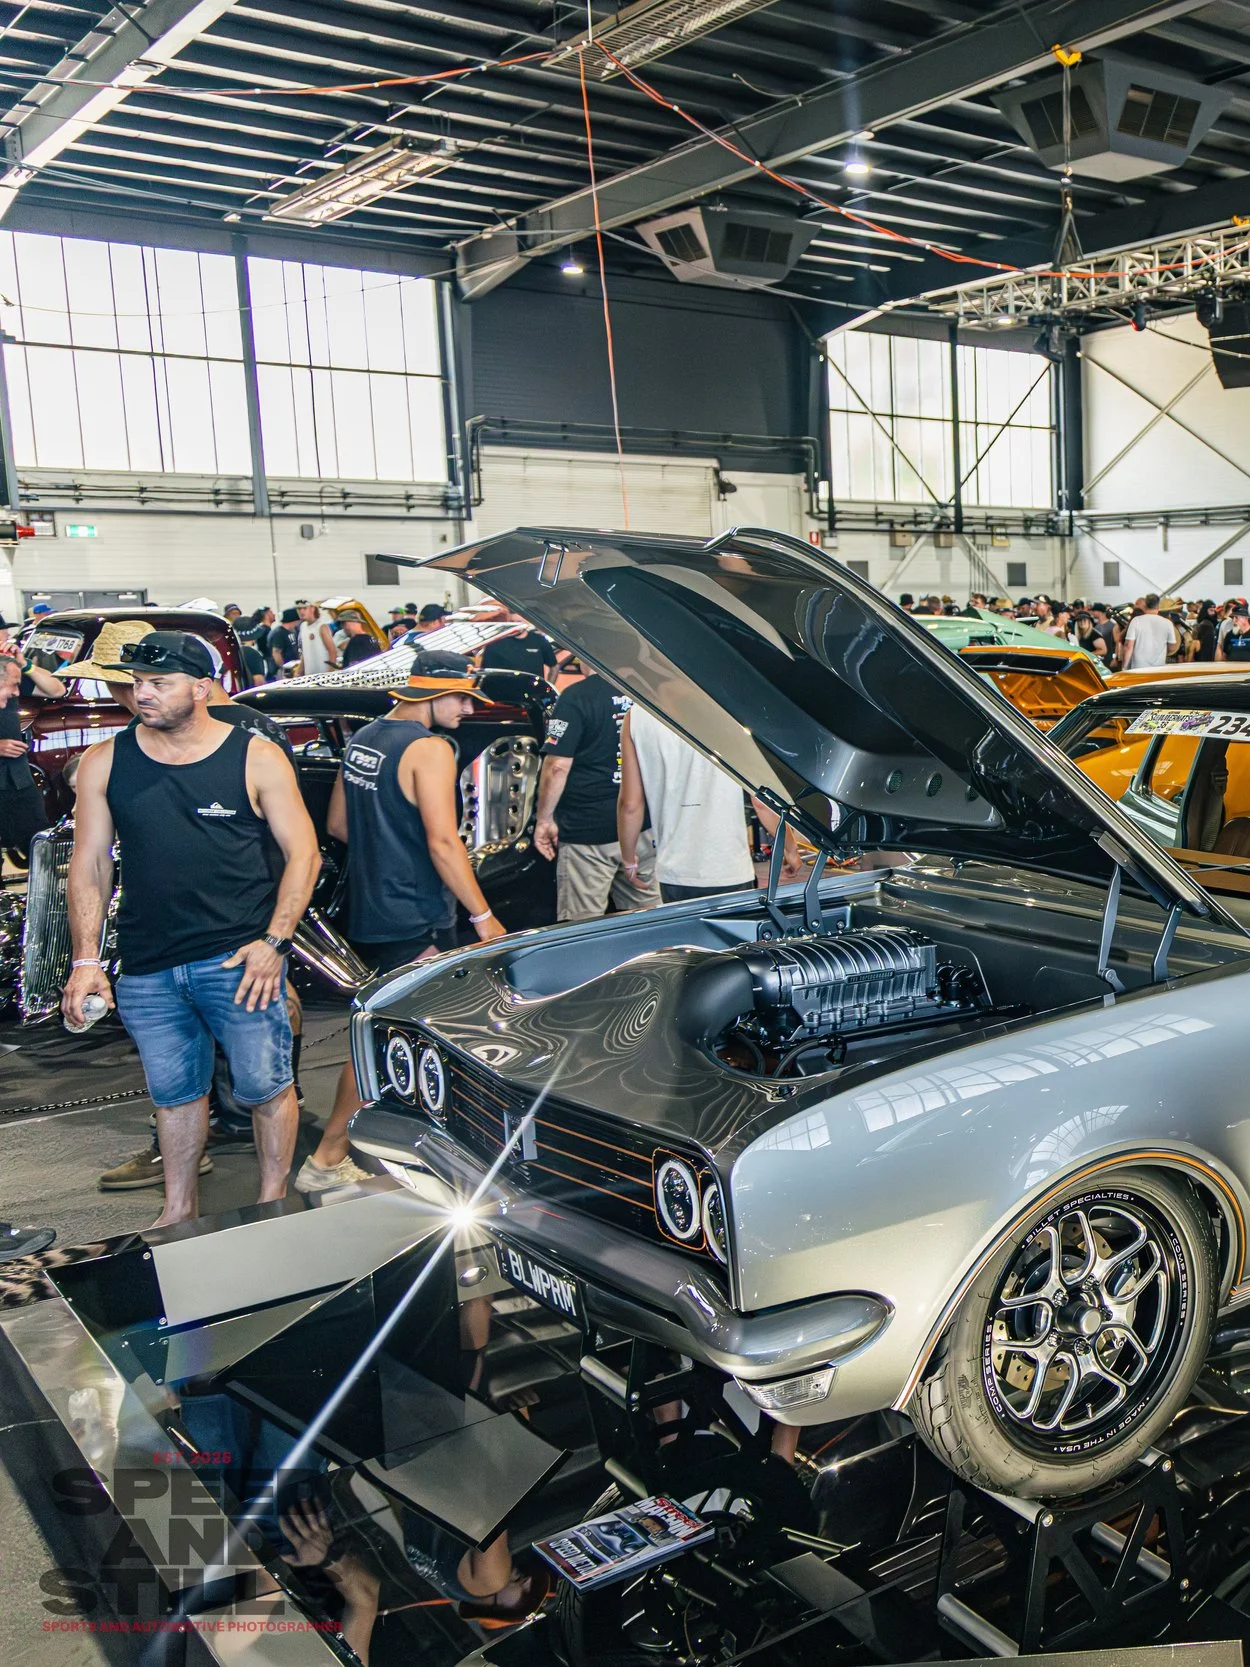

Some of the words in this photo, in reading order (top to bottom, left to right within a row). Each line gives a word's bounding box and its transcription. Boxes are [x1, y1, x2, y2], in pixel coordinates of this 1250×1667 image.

[56, 639, 75, 650] 1768
[1026, 1209, 1061, 1244] BILLET
[1063, 1192, 1129, 1211] SPECIALTIES
[1172, 1238, 1186, 1271] COMP
[508, 1248, 577, 1317] BLWPRM
[984, 1323, 993, 1375] SERIES
[987, 1377, 1003, 1412] COMP
[1106, 1428, 1118, 1438] IN
[1119, 1404, 1146, 1429] MADE
[1059, 1443, 1082, 1453] USA
[1083, 1434, 1105, 1448] THE
[634, 1496, 701, 1537] MACHIN
